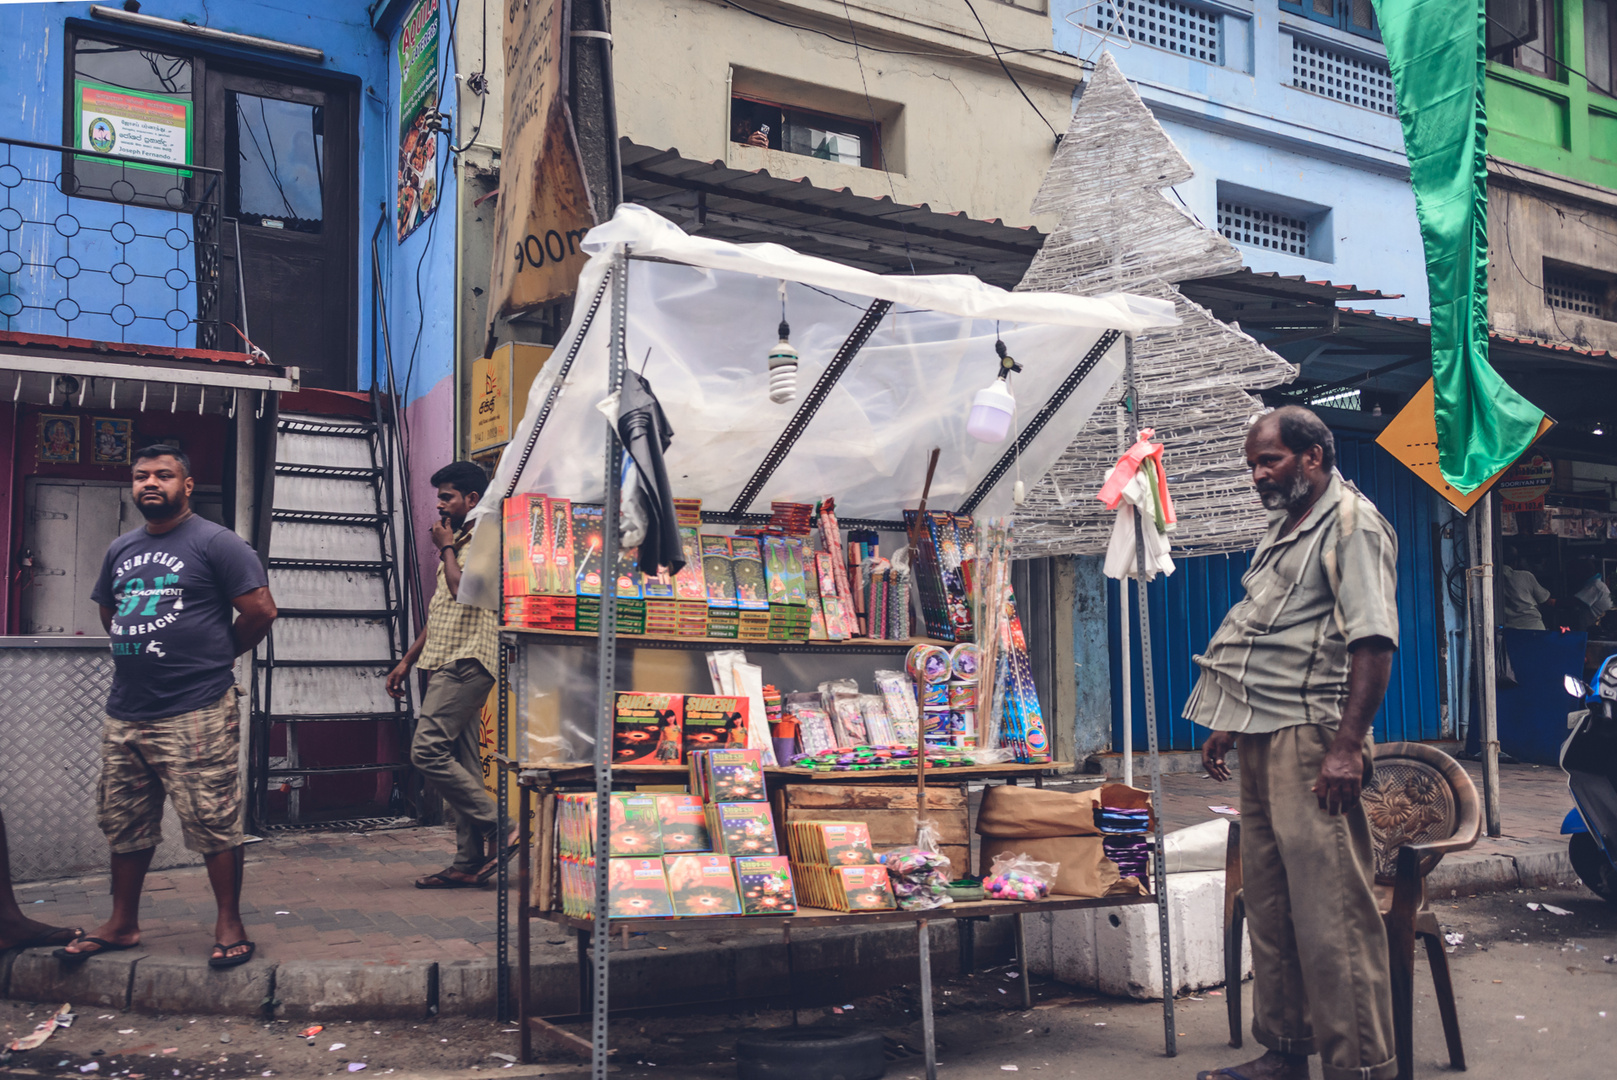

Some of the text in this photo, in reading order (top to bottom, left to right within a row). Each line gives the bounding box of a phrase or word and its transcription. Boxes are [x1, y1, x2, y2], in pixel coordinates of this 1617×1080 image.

[411, 17, 438, 65] CATERERS
[119, 146, 141, 156] Joseph
[141, 150, 170, 160] Fernando
[115, 551, 185, 577] SURF CLUB
[616, 694, 671, 710] SURESH
[685, 696, 737, 712] SURESH
